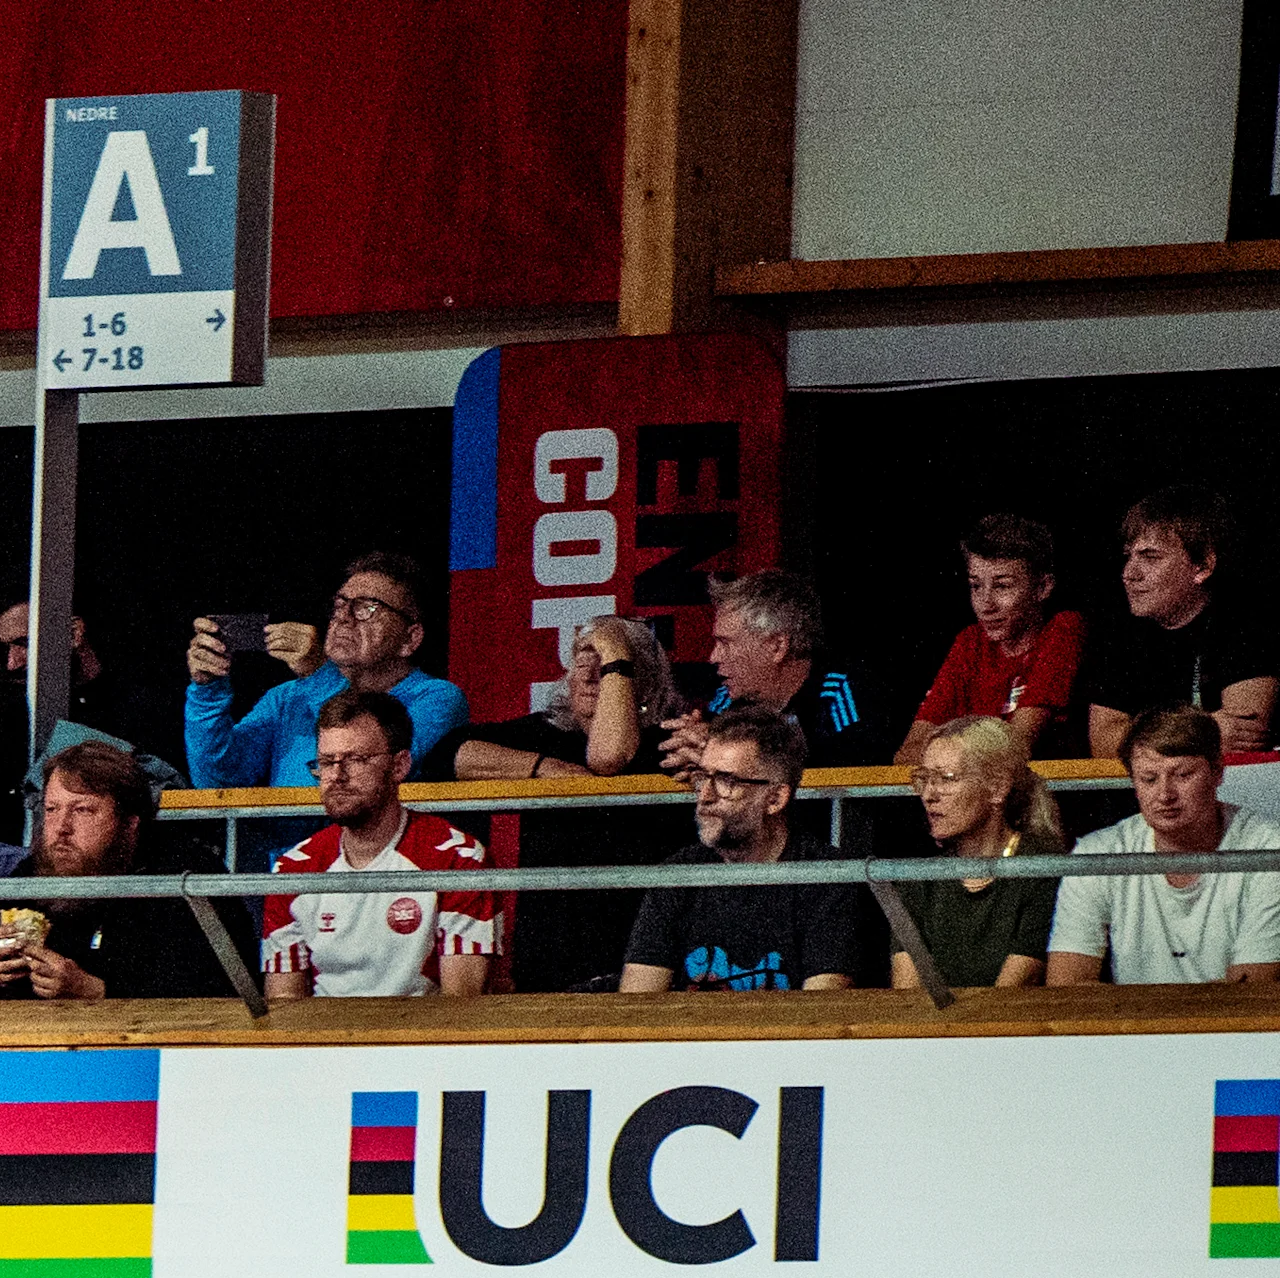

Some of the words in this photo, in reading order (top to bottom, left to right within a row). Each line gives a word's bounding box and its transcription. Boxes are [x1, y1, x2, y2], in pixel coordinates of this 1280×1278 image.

[66, 106, 119, 122] NEDRE
[62, 130, 182, 280] A
[187, 127, 215, 176] 1
[82, 312, 127, 337] 1-6
[81, 346, 144, 371] 7-18
[438, 1085, 825, 1267] UCI
